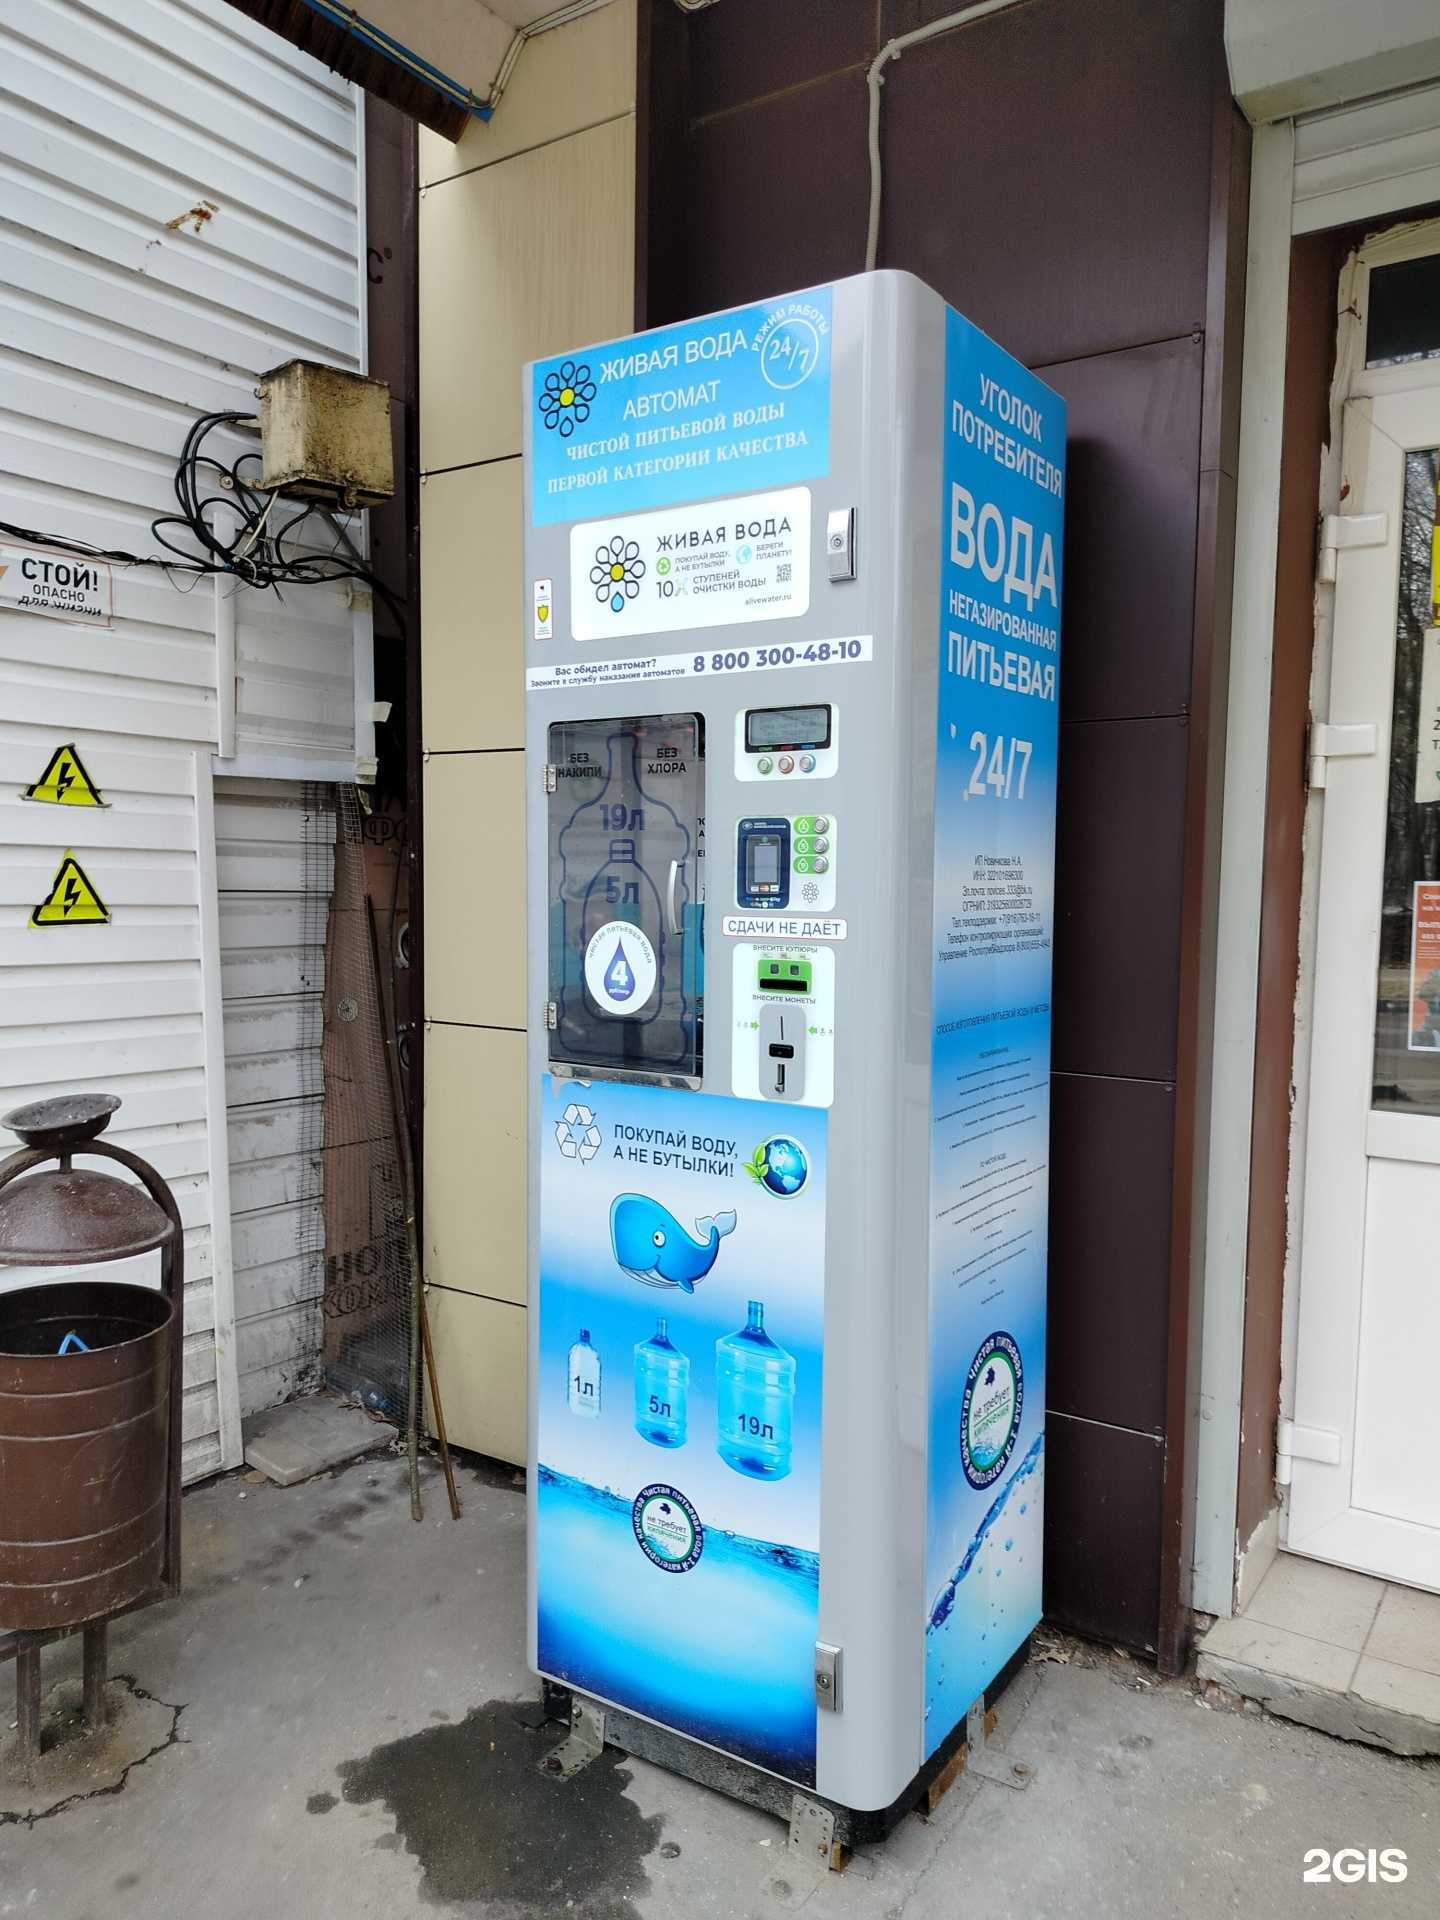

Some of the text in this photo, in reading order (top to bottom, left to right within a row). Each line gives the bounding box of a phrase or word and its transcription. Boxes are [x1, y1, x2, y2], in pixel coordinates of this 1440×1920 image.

[752, 304, 830, 352] РЕЖИМ РАБОТЫ
[600, 329, 748, 385] ЖИВАЯ ВОДА
[769, 335, 810, 371] 24/7
[623, 380, 721, 421] АВТОМАТ
[979, 373, 1042, 443] УГОЛОК
[566, 401, 786, 461] ЧИСТОЙ ПИТЬЕВОЙ ВОДЫ
[547, 430, 809, 494] ПЕРВОЙ КАТЕГОРИИ КАЧЕСТВА
[952, 400, 1062, 498] ПОТРЕБИТЕЛЯ
[656, 516, 792, 553] ЖИВАЯ ВОДА
[950, 481, 1058, 612] ВОДА
[21, 557, 99, 592] СТОЙ!
[693, 569, 740, 585] СТУПЕНЕЙ
[693, 577, 767, 594] ОЧИСТКИ ВОДЫ
[33, 584, 85, 603] ОПАСНО
[656, 580, 674, 599] 10
[949, 589, 1057, 652] НЕГАЗИРОВАННАЯ
[555, 658, 657, 676] Вас обидел автомат?
[693, 640, 862, 673] 8 800 300-48-10
[947, 631, 1056, 702] ПИТЬЕВАЯ
[568, 676, 597, 686] службу
[642, 667, 686, 678] автоматов
[570, 753, 590, 763] БЕЗ
[657, 747, 678, 759] БЕЗ
[968, 730, 1033, 801] 24/7
[558, 766, 602, 778] НАКИПИ
[648, 762, 687, 774] ХЛОРА
[600, 803, 645, 831] 19л
[606, 876, 639, 904] 5л
[728, 919, 841, 936] СДАЧИ НЕ ДАЁТ
[752, 944, 785, 952] ВНЕСИТЕ
[611, 960, 628, 986] 4
[752, 994, 816, 1005] ВНЕСИТЕ МОНЕТЫ
[614, 1124, 738, 1158] ПОКУПАЙ ВОДУ,
[613, 1145, 734, 1177] А НЕ БУТЫЛКИ!
[573, 1375, 593, 1396] 1л
[649, 1395, 671, 1417] 5л
[737, 1413, 774, 1440] 19л
[658, 1518, 687, 1534] требует
